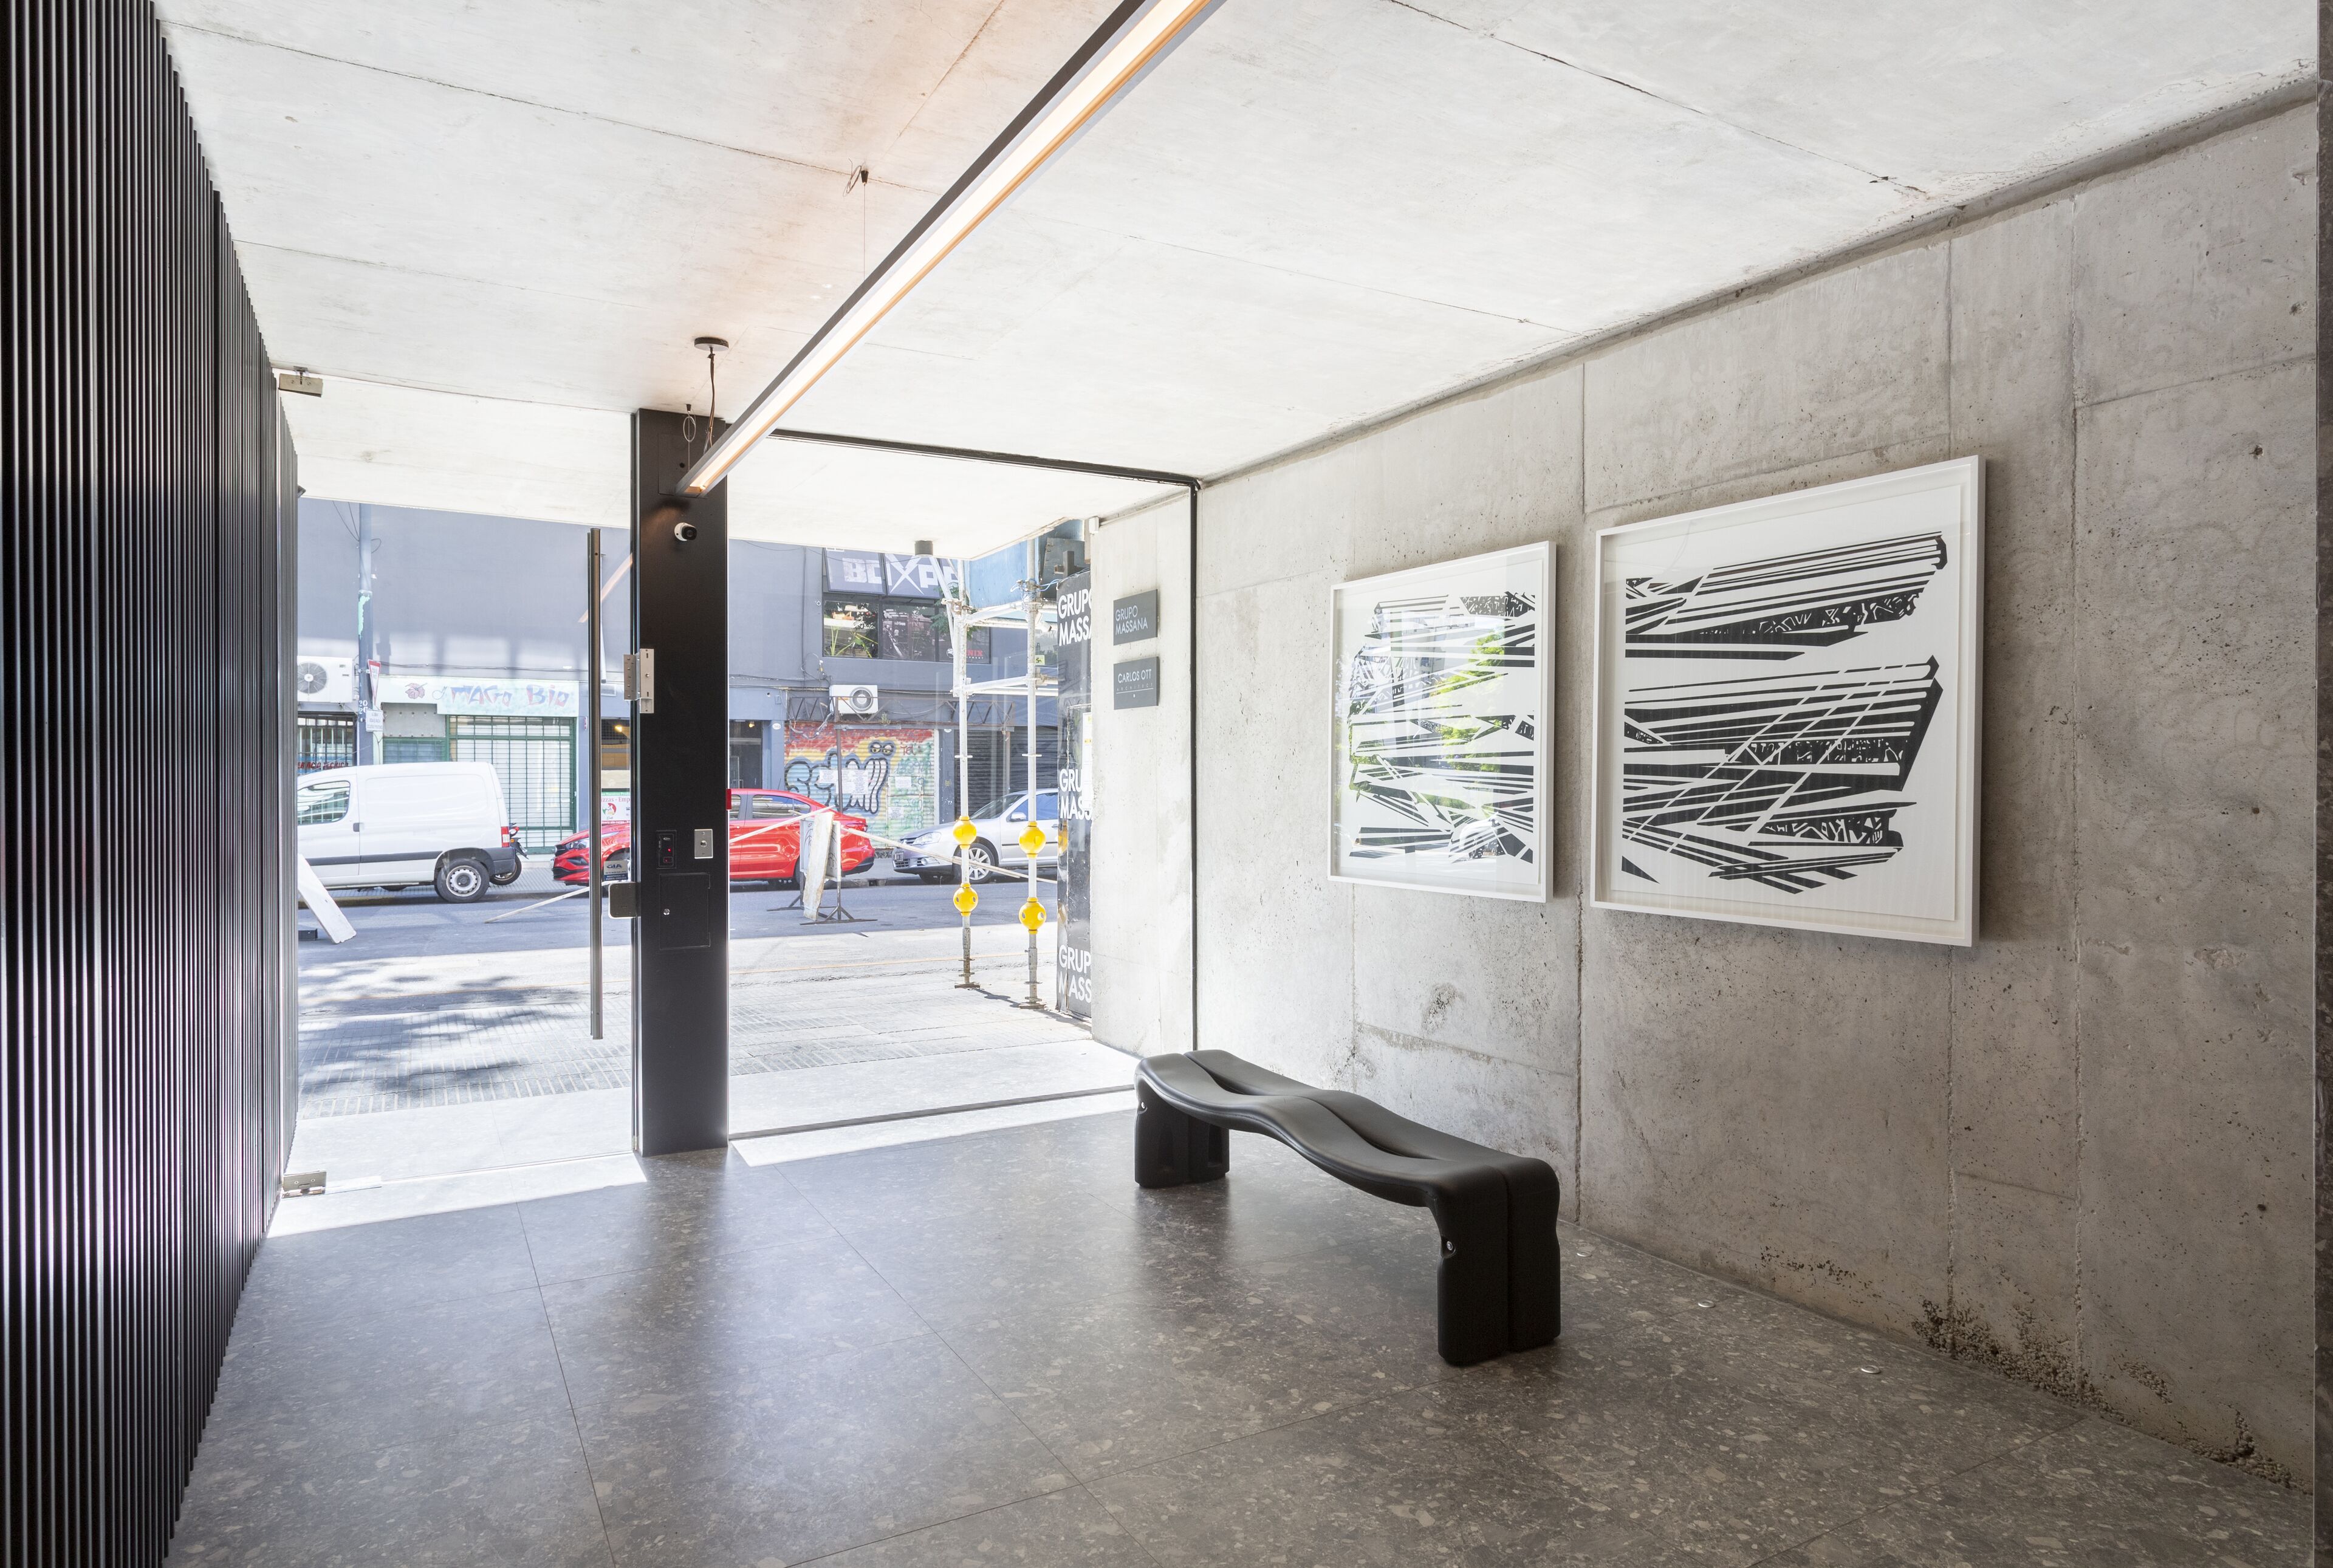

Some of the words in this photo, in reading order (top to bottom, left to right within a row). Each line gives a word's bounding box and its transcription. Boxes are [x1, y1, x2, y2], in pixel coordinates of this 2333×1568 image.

[1115, 605, 1138, 622] GRUPO
[1059, 615, 1091, 646] MASS
[1115, 617, 1148, 635] MASSANA
[1117, 671, 1140, 684] CARLOS
[1140, 669, 1152, 680] OTT
[1117, 682, 1153, 691] ARCHITECT
[526, 684, 569, 707] Bio
